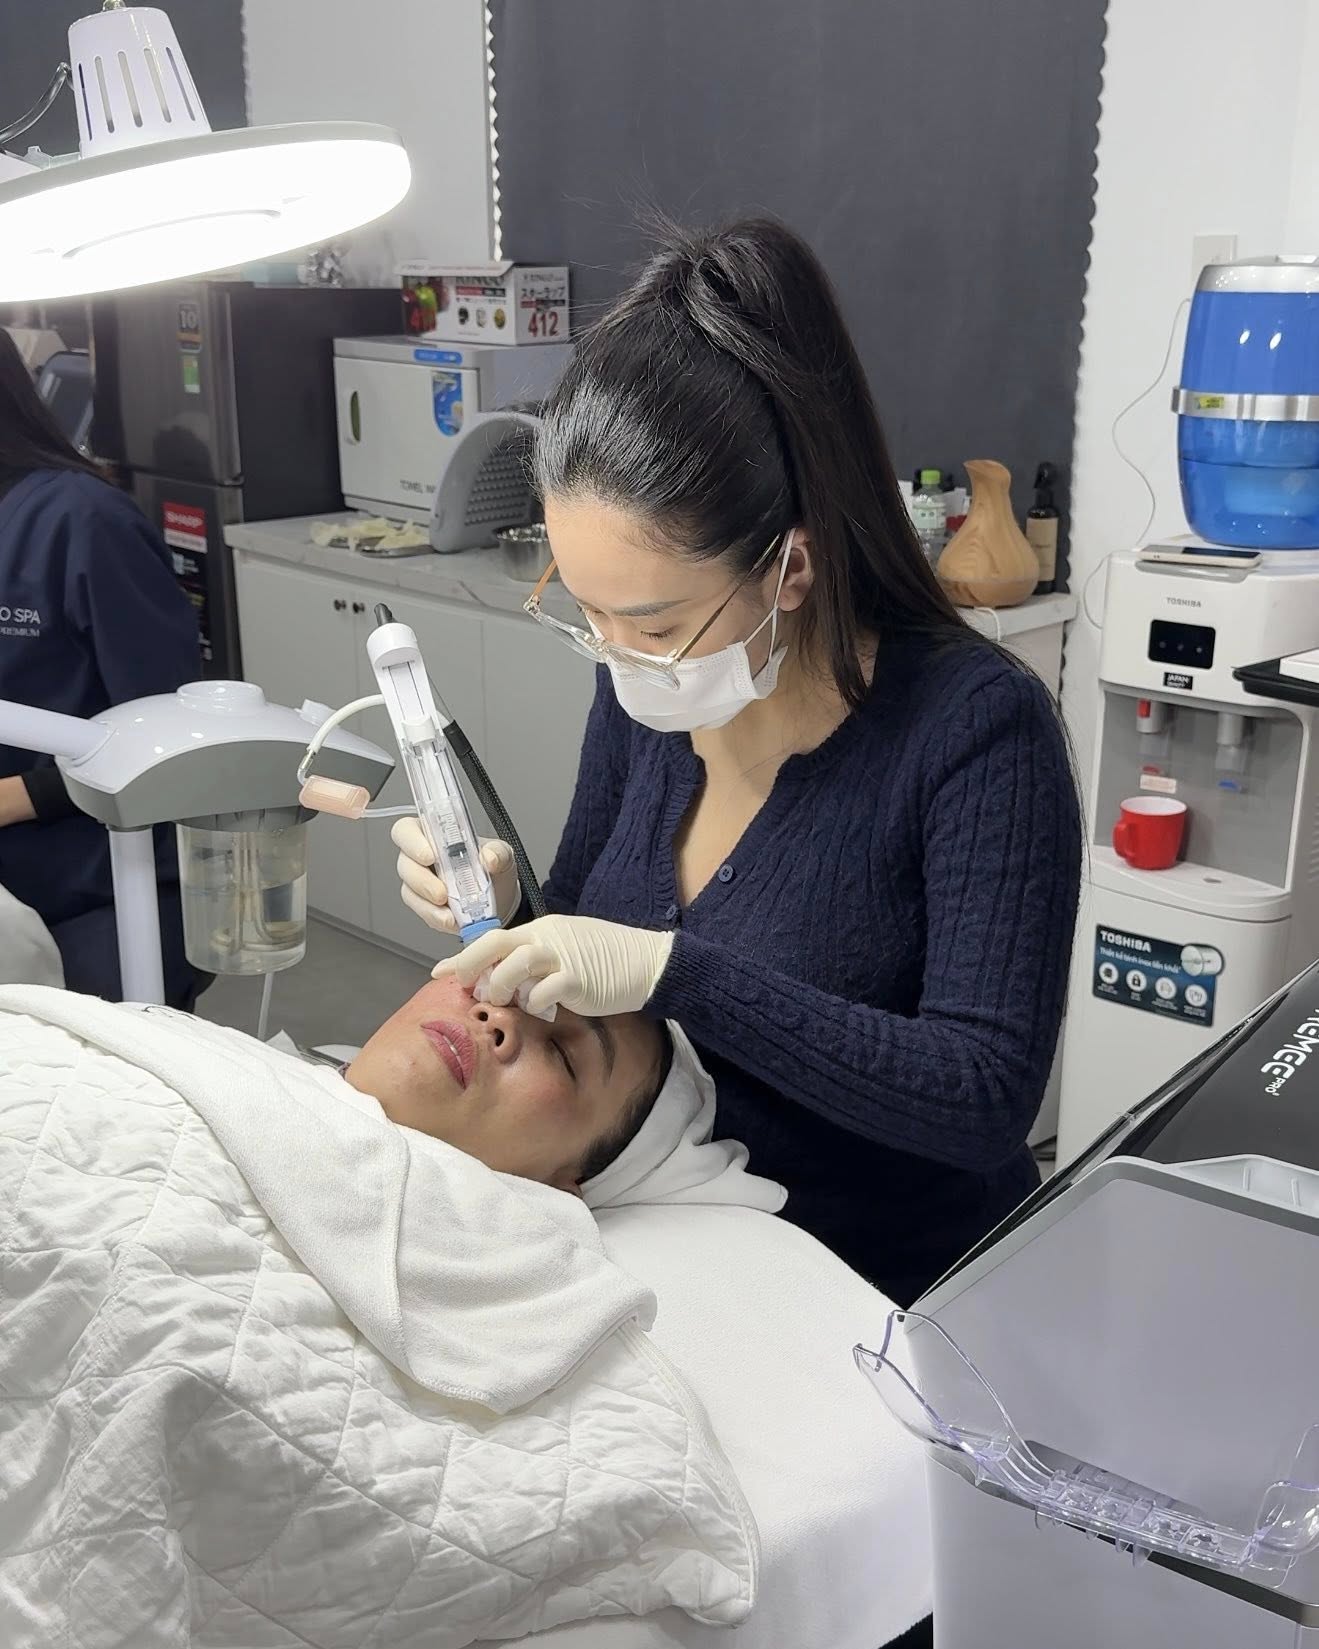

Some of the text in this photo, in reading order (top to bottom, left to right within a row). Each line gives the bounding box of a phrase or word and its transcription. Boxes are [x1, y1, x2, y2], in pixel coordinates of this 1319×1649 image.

[528, 311, 559, 337] 412
[164, 510, 204, 529] SHARP
[1166, 597, 1202, 608] TOSHIBA
[14, 607, 41, 625] SPA
[1100, 930, 1152, 953] TOSHIBA
